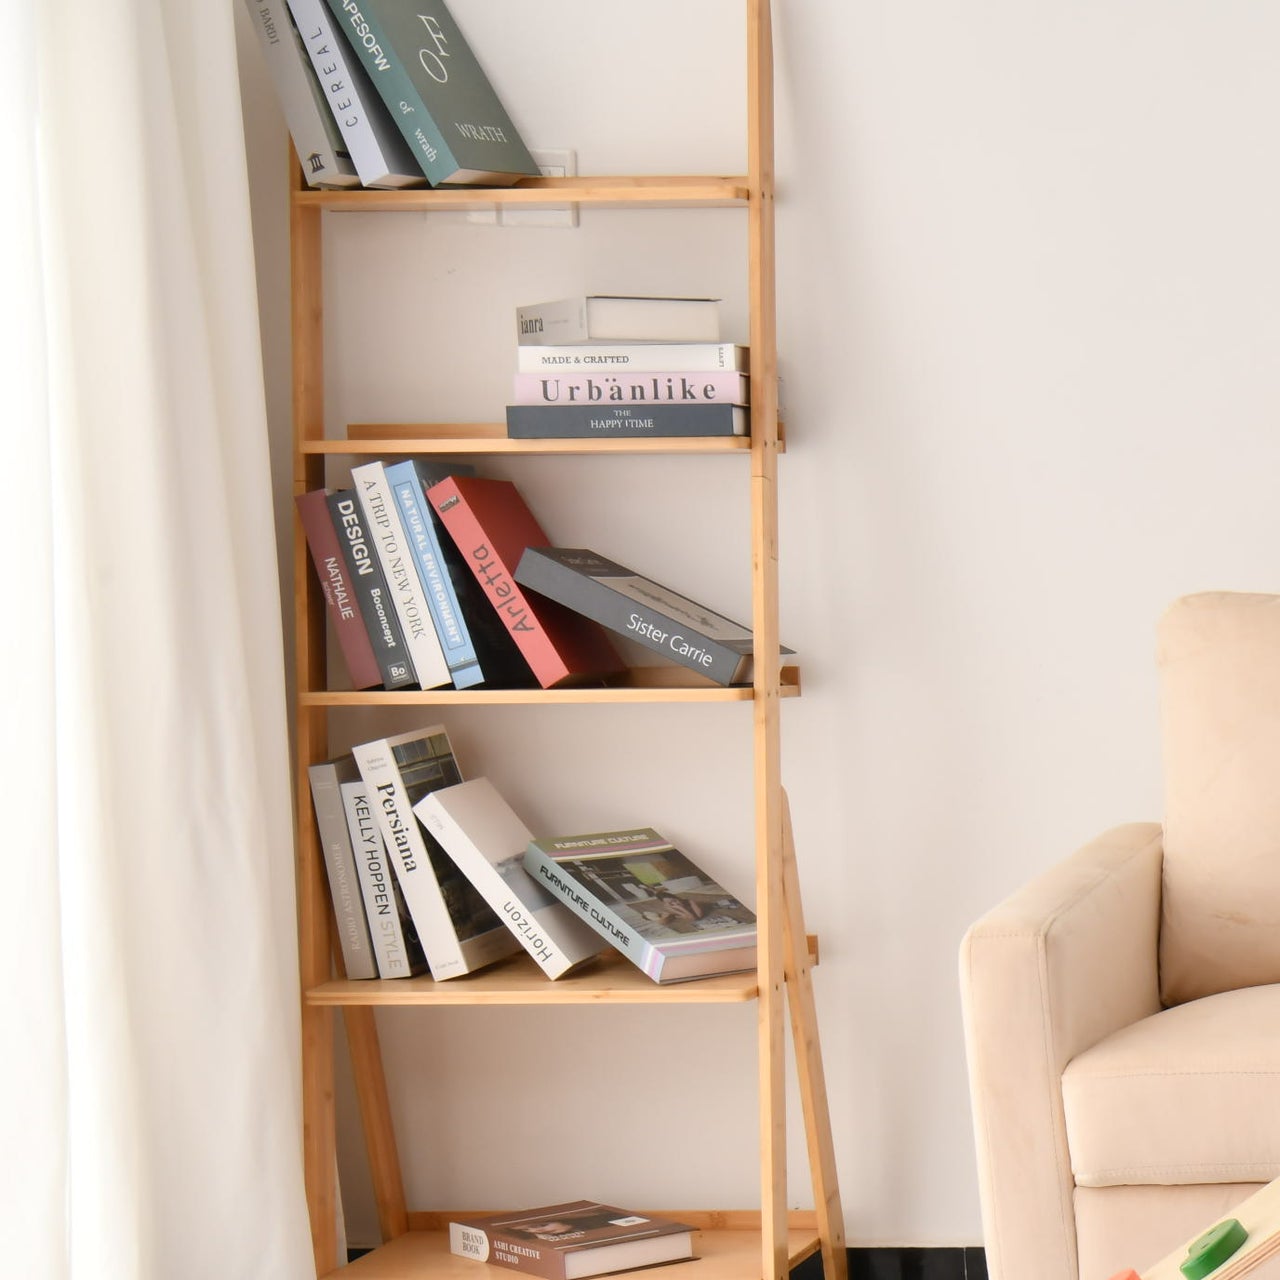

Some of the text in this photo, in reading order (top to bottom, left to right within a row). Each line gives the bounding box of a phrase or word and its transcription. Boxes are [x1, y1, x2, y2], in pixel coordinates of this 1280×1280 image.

[311, 27, 358, 128] CEREAL
[399, 100, 415, 115] of
[414, 128, 437, 162] wrath
[455, 122, 507, 143] WRATH
[541, 355, 630, 364] MADE & CRAFTED
[540, 378, 716, 402] Urbänlike
[590, 418, 623, 429] HAPPY
[613, 409, 632, 418] THE
[337, 500, 374, 576] DESIGN
[363, 480, 426, 640] A TRIP TO NEW YORK
[400, 489, 428, 551] NATURAL
[422, 553, 463, 644] ENVIRONMENT
[472, 543, 535, 632] Arletta
[324, 557, 355, 621] NATHALIE
[370, 588, 397, 648] Boconcept
[626, 613, 713, 668] Sister Carrie
[390, 666, 406, 677] Bo
[376, 782, 418, 873] Persiana
[353, 795, 377, 845] KELLY
[365, 850, 391, 915] HOPPEN
[381, 920, 402, 969] STYLE
[540, 865, 631, 947] FURNITURE CULTURE
[503, 900, 553, 962] Horizon
[461, 1231, 484, 1245] BRAND
[461, 1243, 480, 1255] BOOK
[493, 1240, 541, 1260] ASHI CREATIVE
[495, 1252, 519, 1265] STUDIO
